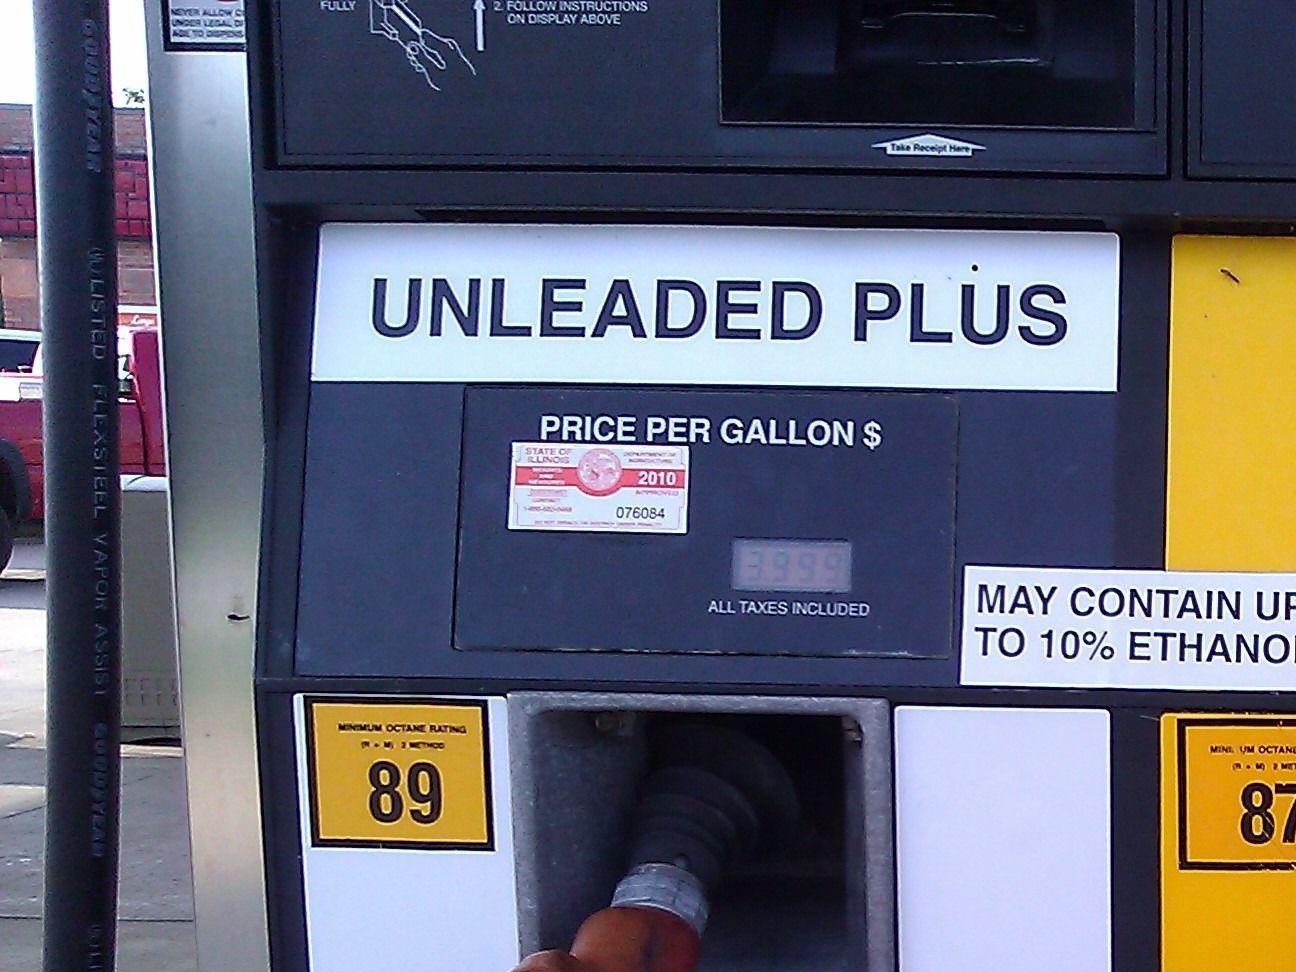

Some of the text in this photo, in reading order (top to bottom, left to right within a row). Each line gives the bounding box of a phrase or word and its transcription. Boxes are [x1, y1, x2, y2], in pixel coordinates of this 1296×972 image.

[321, 1, 356, 10] FULLY
[507, 1, 555, 11] FOLLOW
[559, 1, 648, 12] INSTRUCTIONS
[507, 14, 621, 24] ON DISPLAY ABOVE
[891, 143, 971, 154] Take Receipt Here
[89, 280, 107, 360] LISTED
[373, 278, 1067, 345] UNLEADED PLUS
[540, 416, 881, 449] PRICE PER GALLON $
[91, 384, 109, 519] FLEXSTEEL
[639, 471, 676, 485] 2010
[616, 506, 665, 520] 076084
[92, 531, 109, 609] VAPOR
[708, 601, 870, 616] ALL TAXES INCLUDED
[978, 584, 1057, 615] MAY
[1071, 587, 1241, 620] CONTAIN
[975, 627, 1024, 657] TO
[1041, 630, 1114, 660] 10%
[93, 622, 109, 697] ASSIST
[338, 723, 467, 734] MINIMUM OCTANE RATING
[409, 741, 445, 749] METHOD
[369, 761, 441, 824] 89
